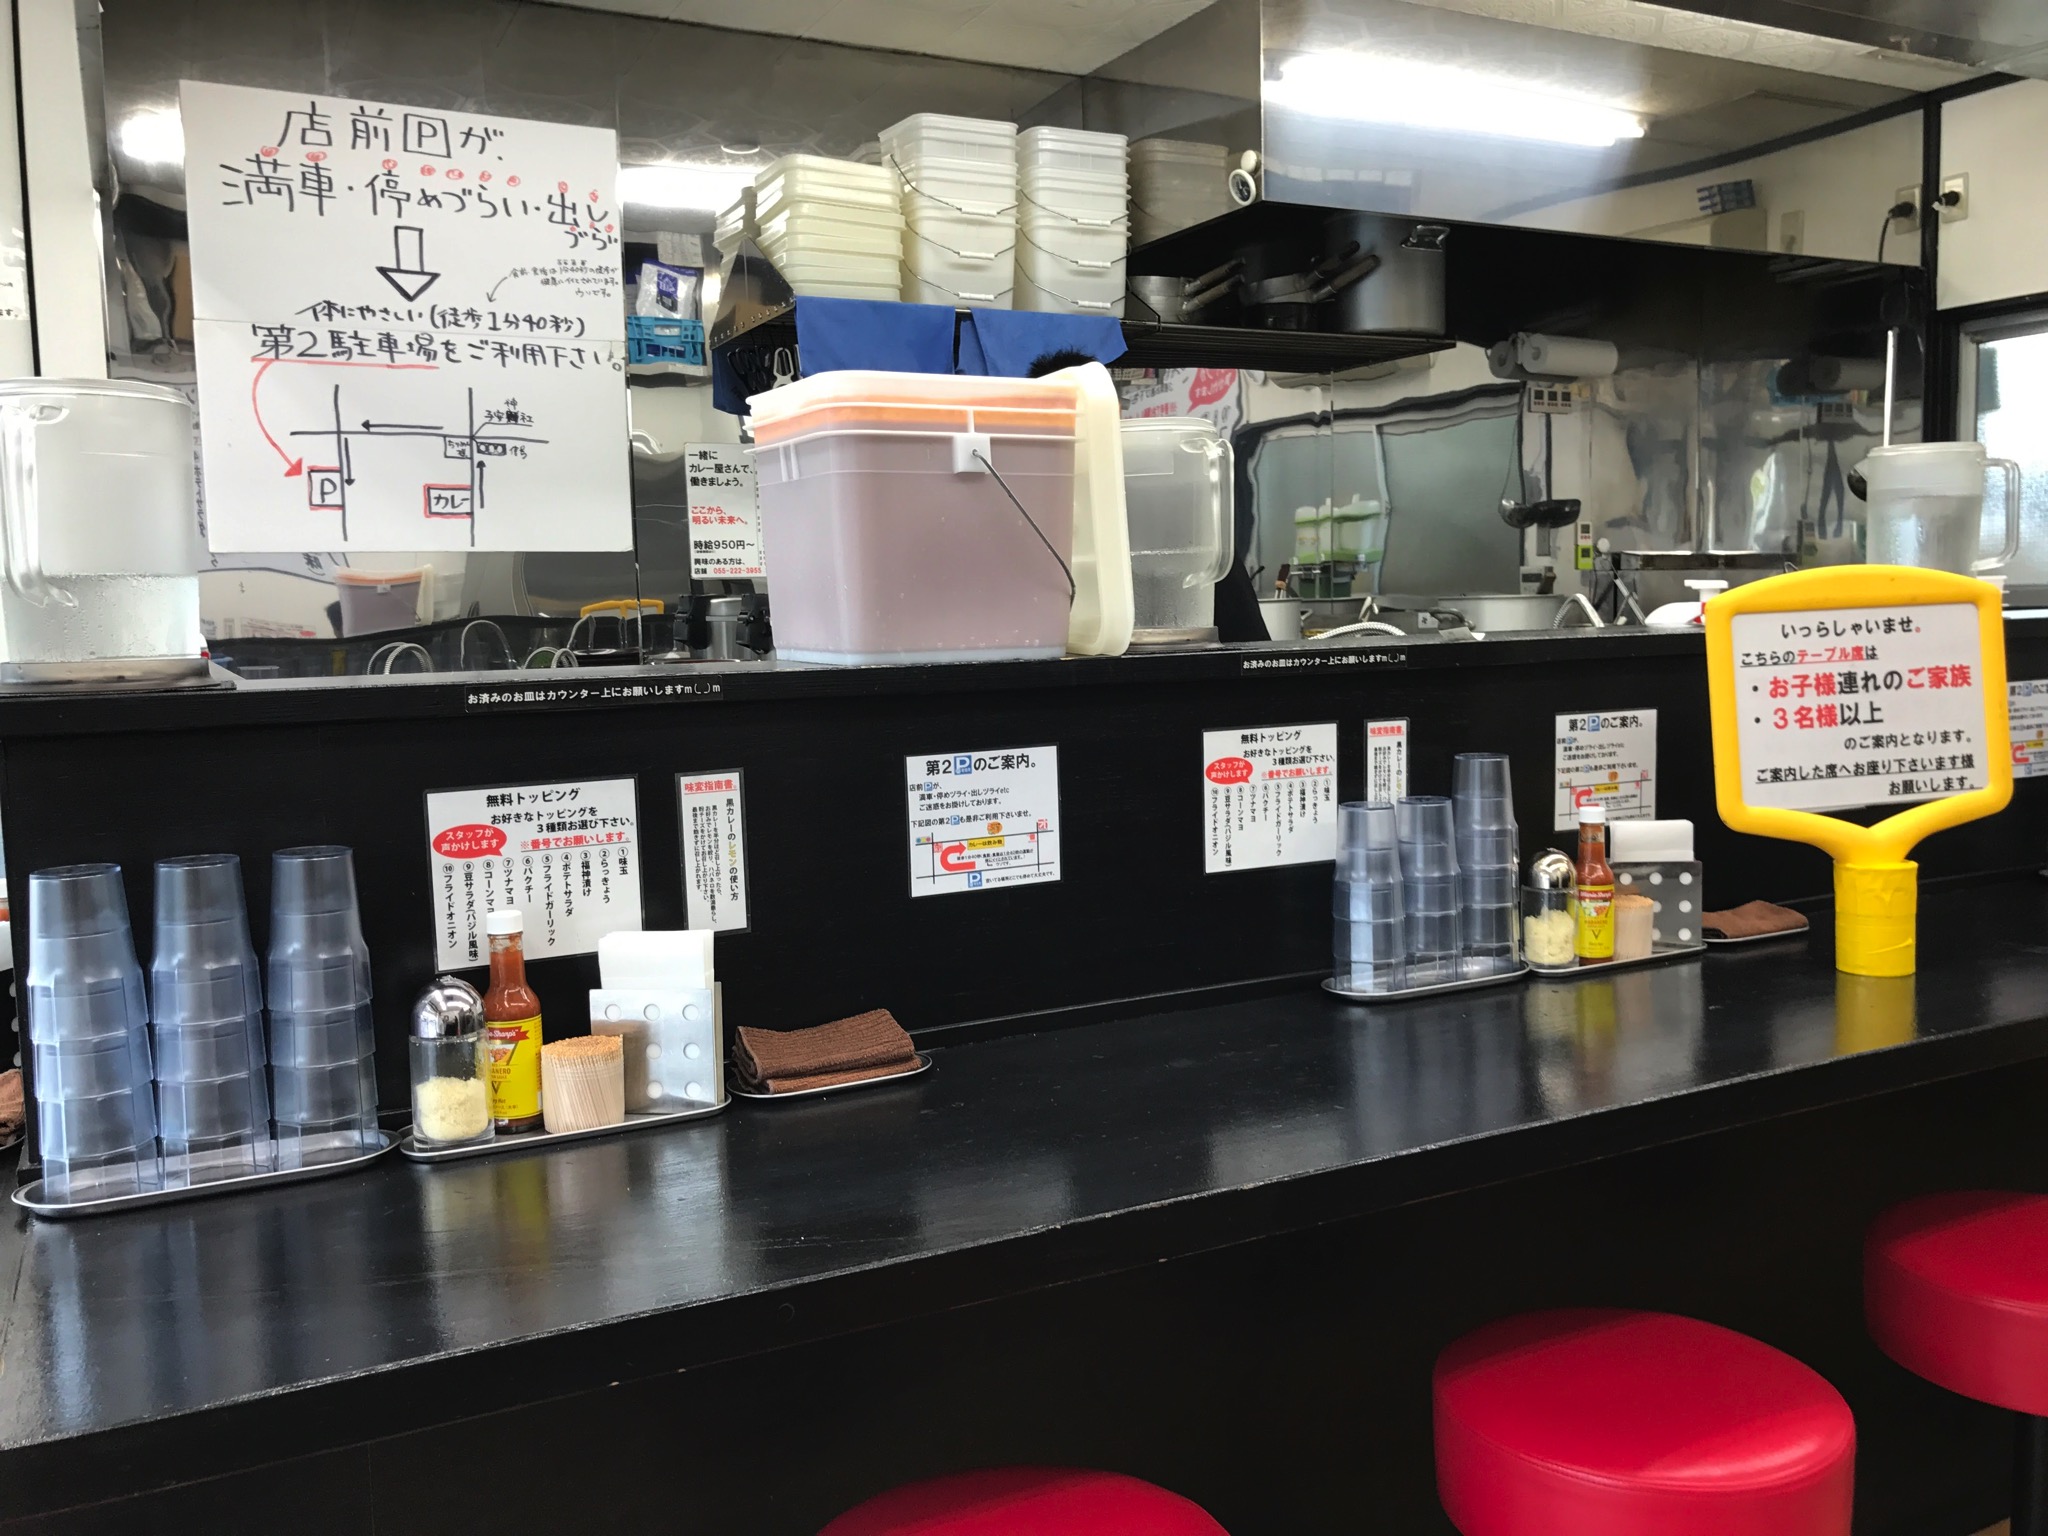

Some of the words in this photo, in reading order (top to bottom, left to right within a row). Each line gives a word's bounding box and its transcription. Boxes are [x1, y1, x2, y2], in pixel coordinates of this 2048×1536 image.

[688, 450, 719, 461] 一緒に
[688, 463, 754, 475] カレー屋さんで、
[689, 476, 744, 488] 働きましょう。
[320, 478, 337, 502] P
[433, 493, 470, 510] カレー
[691, 506, 726, 516] ここから、
[691, 515, 749, 526] 明るい未来へ。
[694, 558, 745, 566] 興味のある方は、
[1740, 645, 1879, 666] こちらのテーブル席は
[1240, 730, 1302, 744] 無料トッピング
[1844, 729, 1973, 751] のご案内となります。
[1243, 745, 1313, 759] お好きなトッピングを
[1213, 761, 1245, 770] スタッフが
[1755, 753, 1975, 783] ご案内した席へお座り下さいます様
[1210, 769, 1249, 779] 声かけします
[1888, 777, 1975, 796] お願いします。
[485, 787, 581, 808] 無料トッピング
[490, 806, 598, 825] お好きなトッピングを
[445, 829, 494, 841] スタッフが
[441, 838, 500, 853] 声かけします
[725, 798, 739, 902] 黒カレーのレモンの使い方
